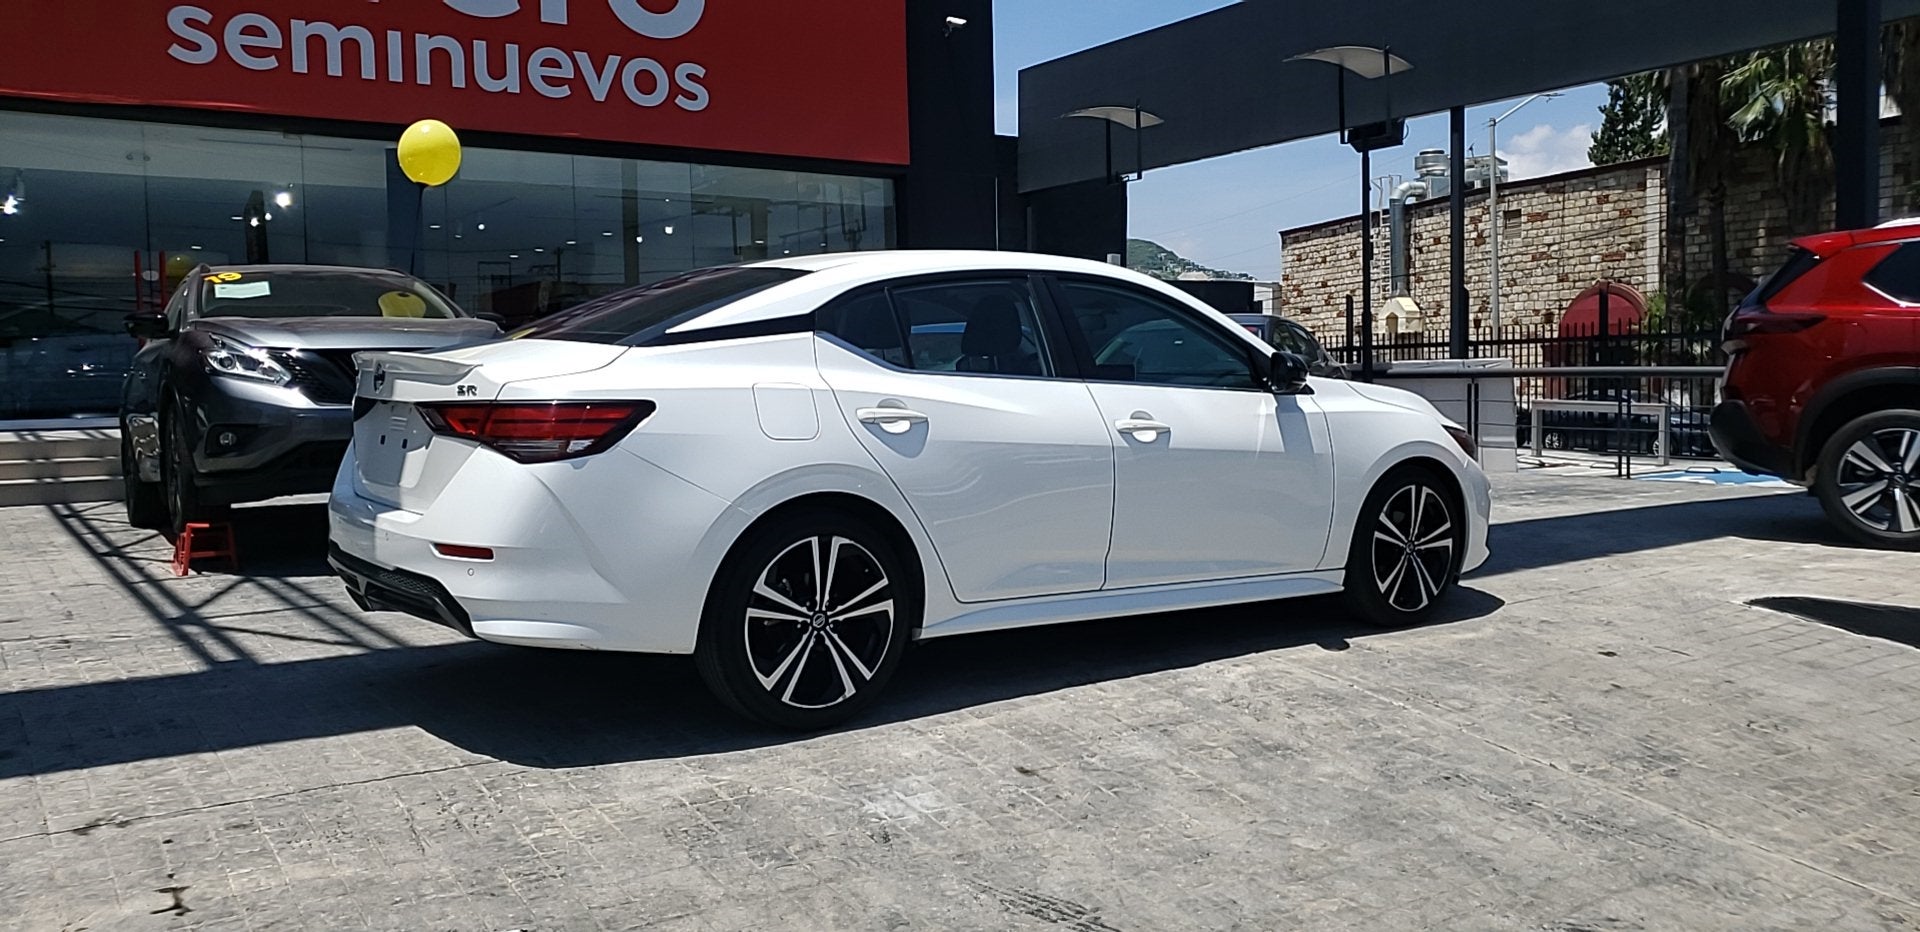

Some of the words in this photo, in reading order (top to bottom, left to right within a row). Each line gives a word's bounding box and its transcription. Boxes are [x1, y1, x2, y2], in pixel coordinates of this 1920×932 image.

[167, 5, 710, 111] seminuevos
[204, 272, 242, 283] 19
[456, 385, 478, 397] SR
